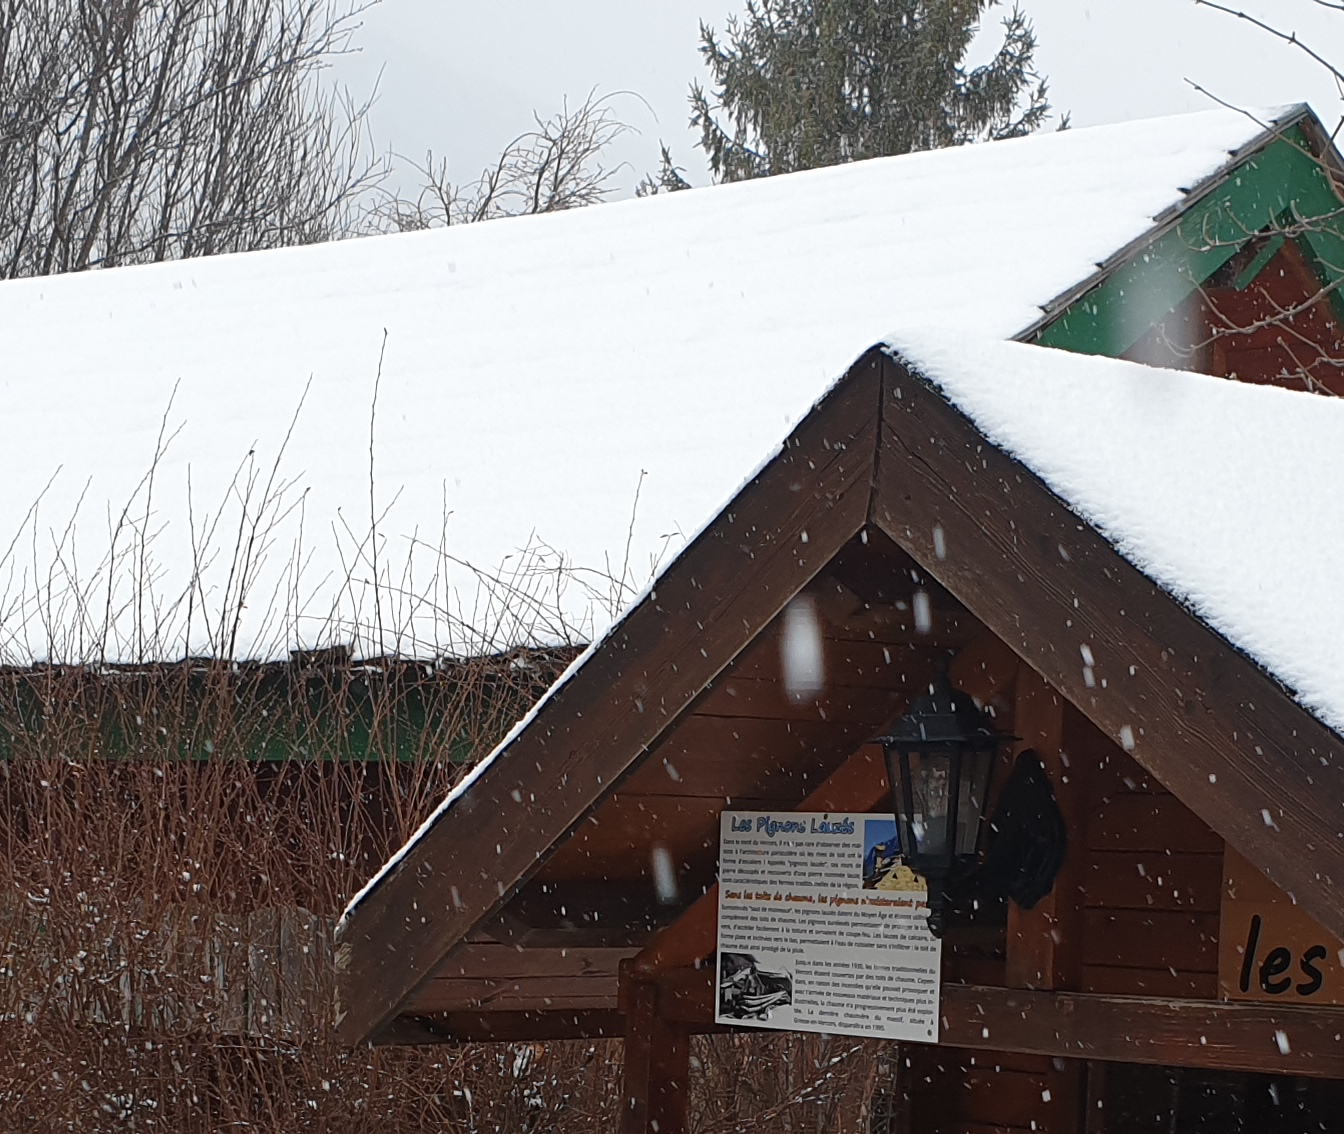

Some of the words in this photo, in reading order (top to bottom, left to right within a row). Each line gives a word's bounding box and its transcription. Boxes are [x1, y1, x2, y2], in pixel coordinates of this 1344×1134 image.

[731, 815, 753, 832] Les
[756, 815, 807, 838] Pignons
[1239, 914, 1327, 996] les
